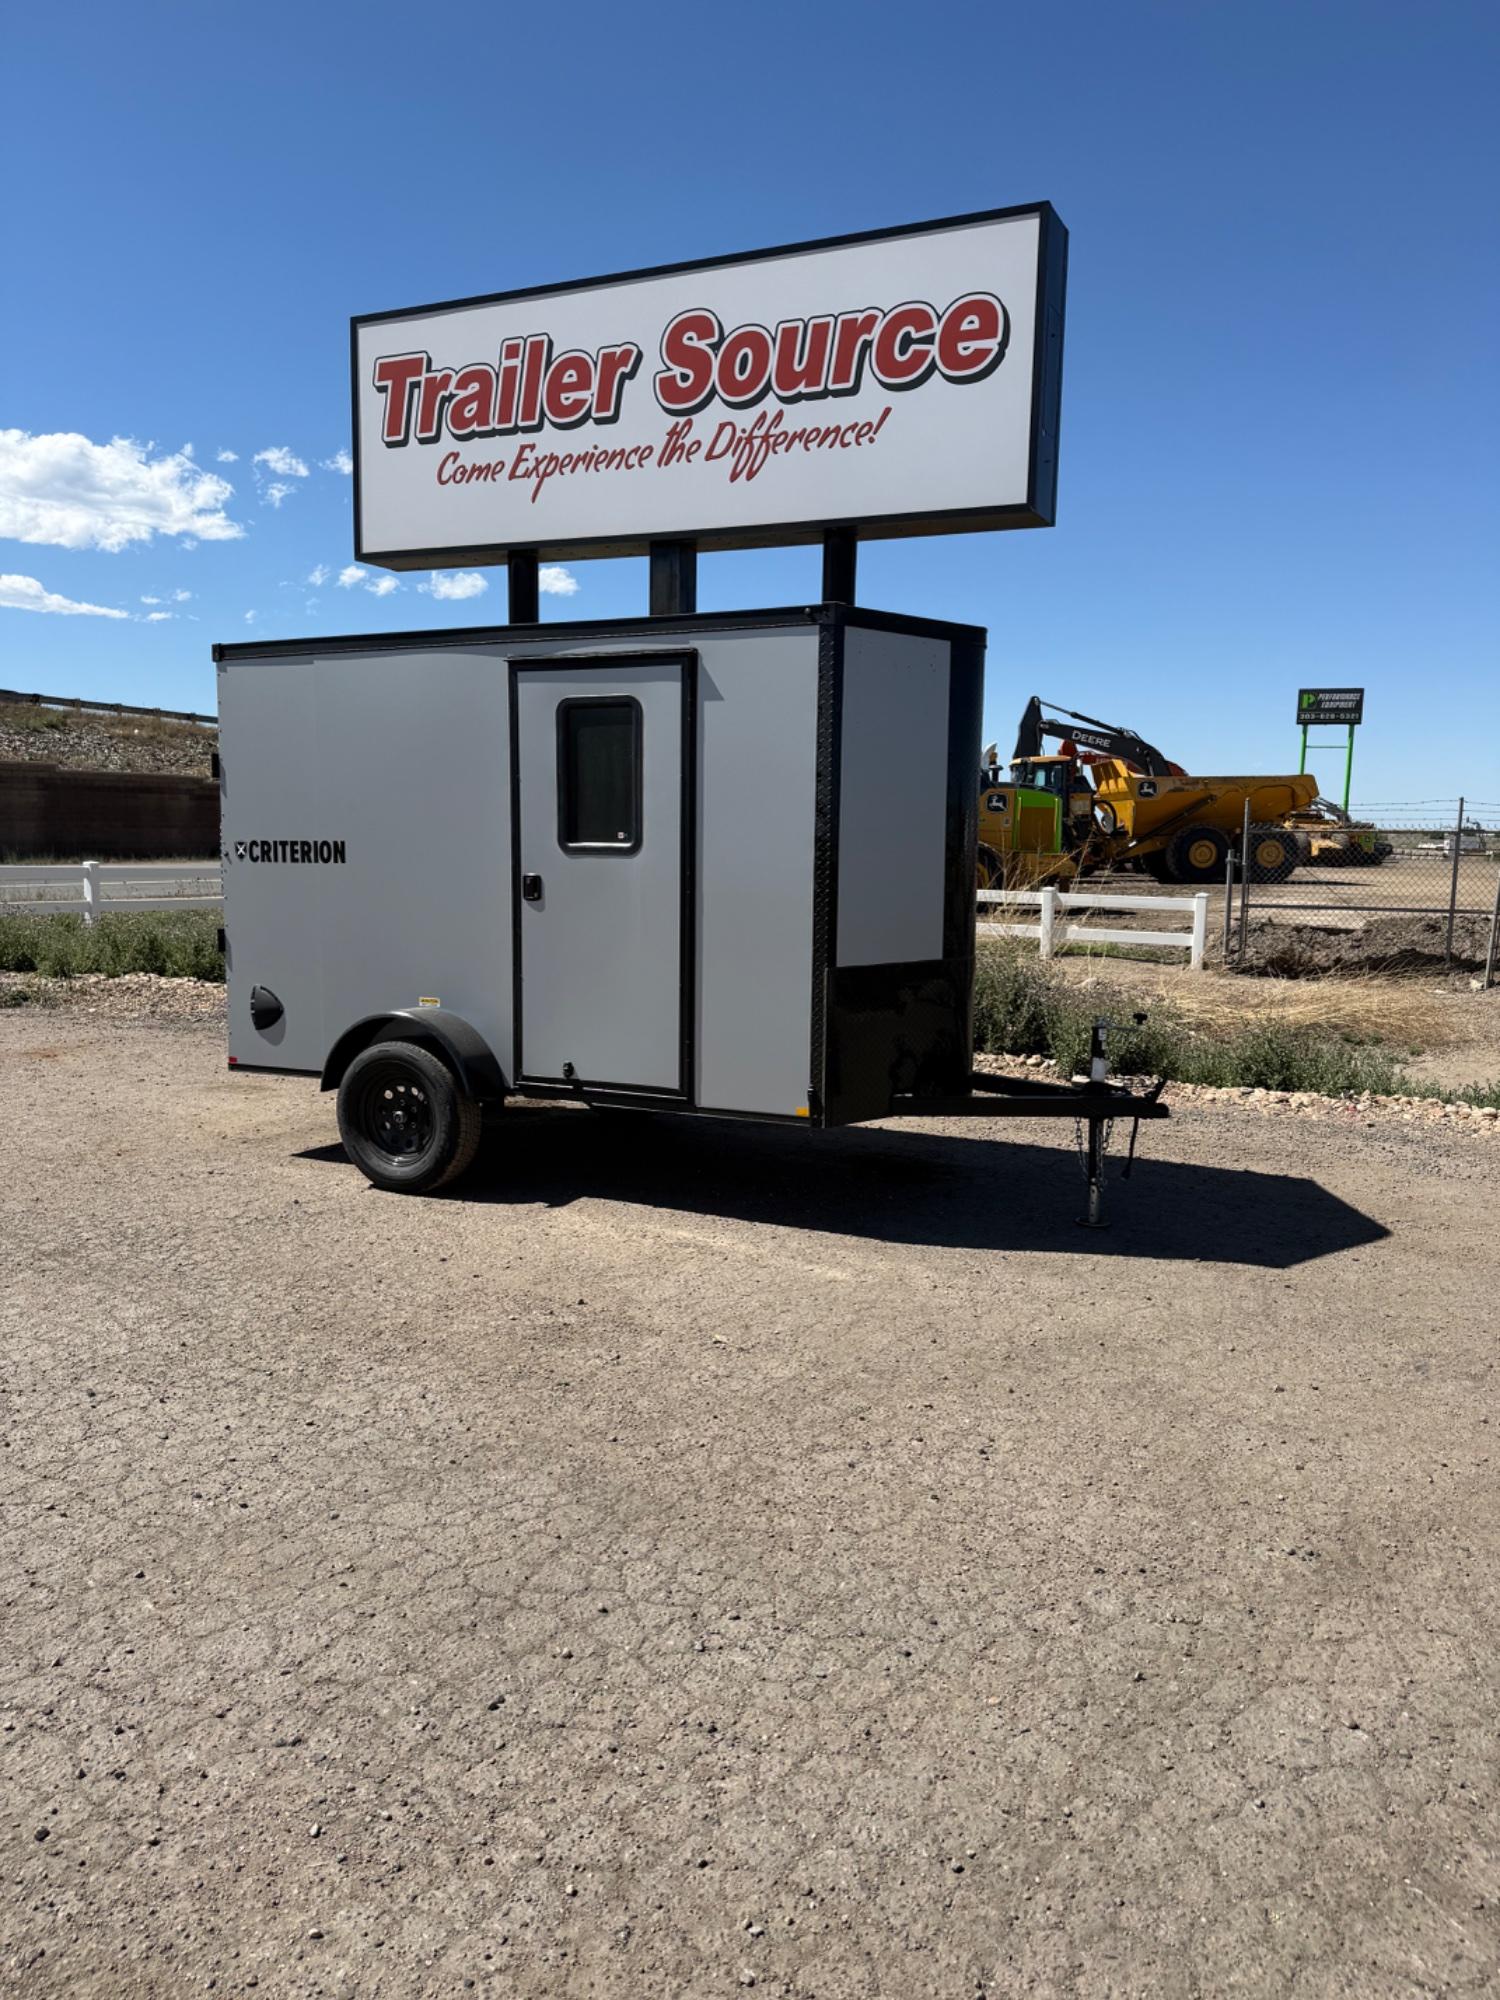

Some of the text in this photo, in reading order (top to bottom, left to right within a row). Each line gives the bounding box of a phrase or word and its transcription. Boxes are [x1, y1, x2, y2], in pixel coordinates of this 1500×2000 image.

[373, 291, 1011, 447] Trailer Source
[437, 406, 892, 503] Come Experience the Difference!
[1072, 729, 1111, 747] DEERE
[249, 840, 346, 863] CRITERION
